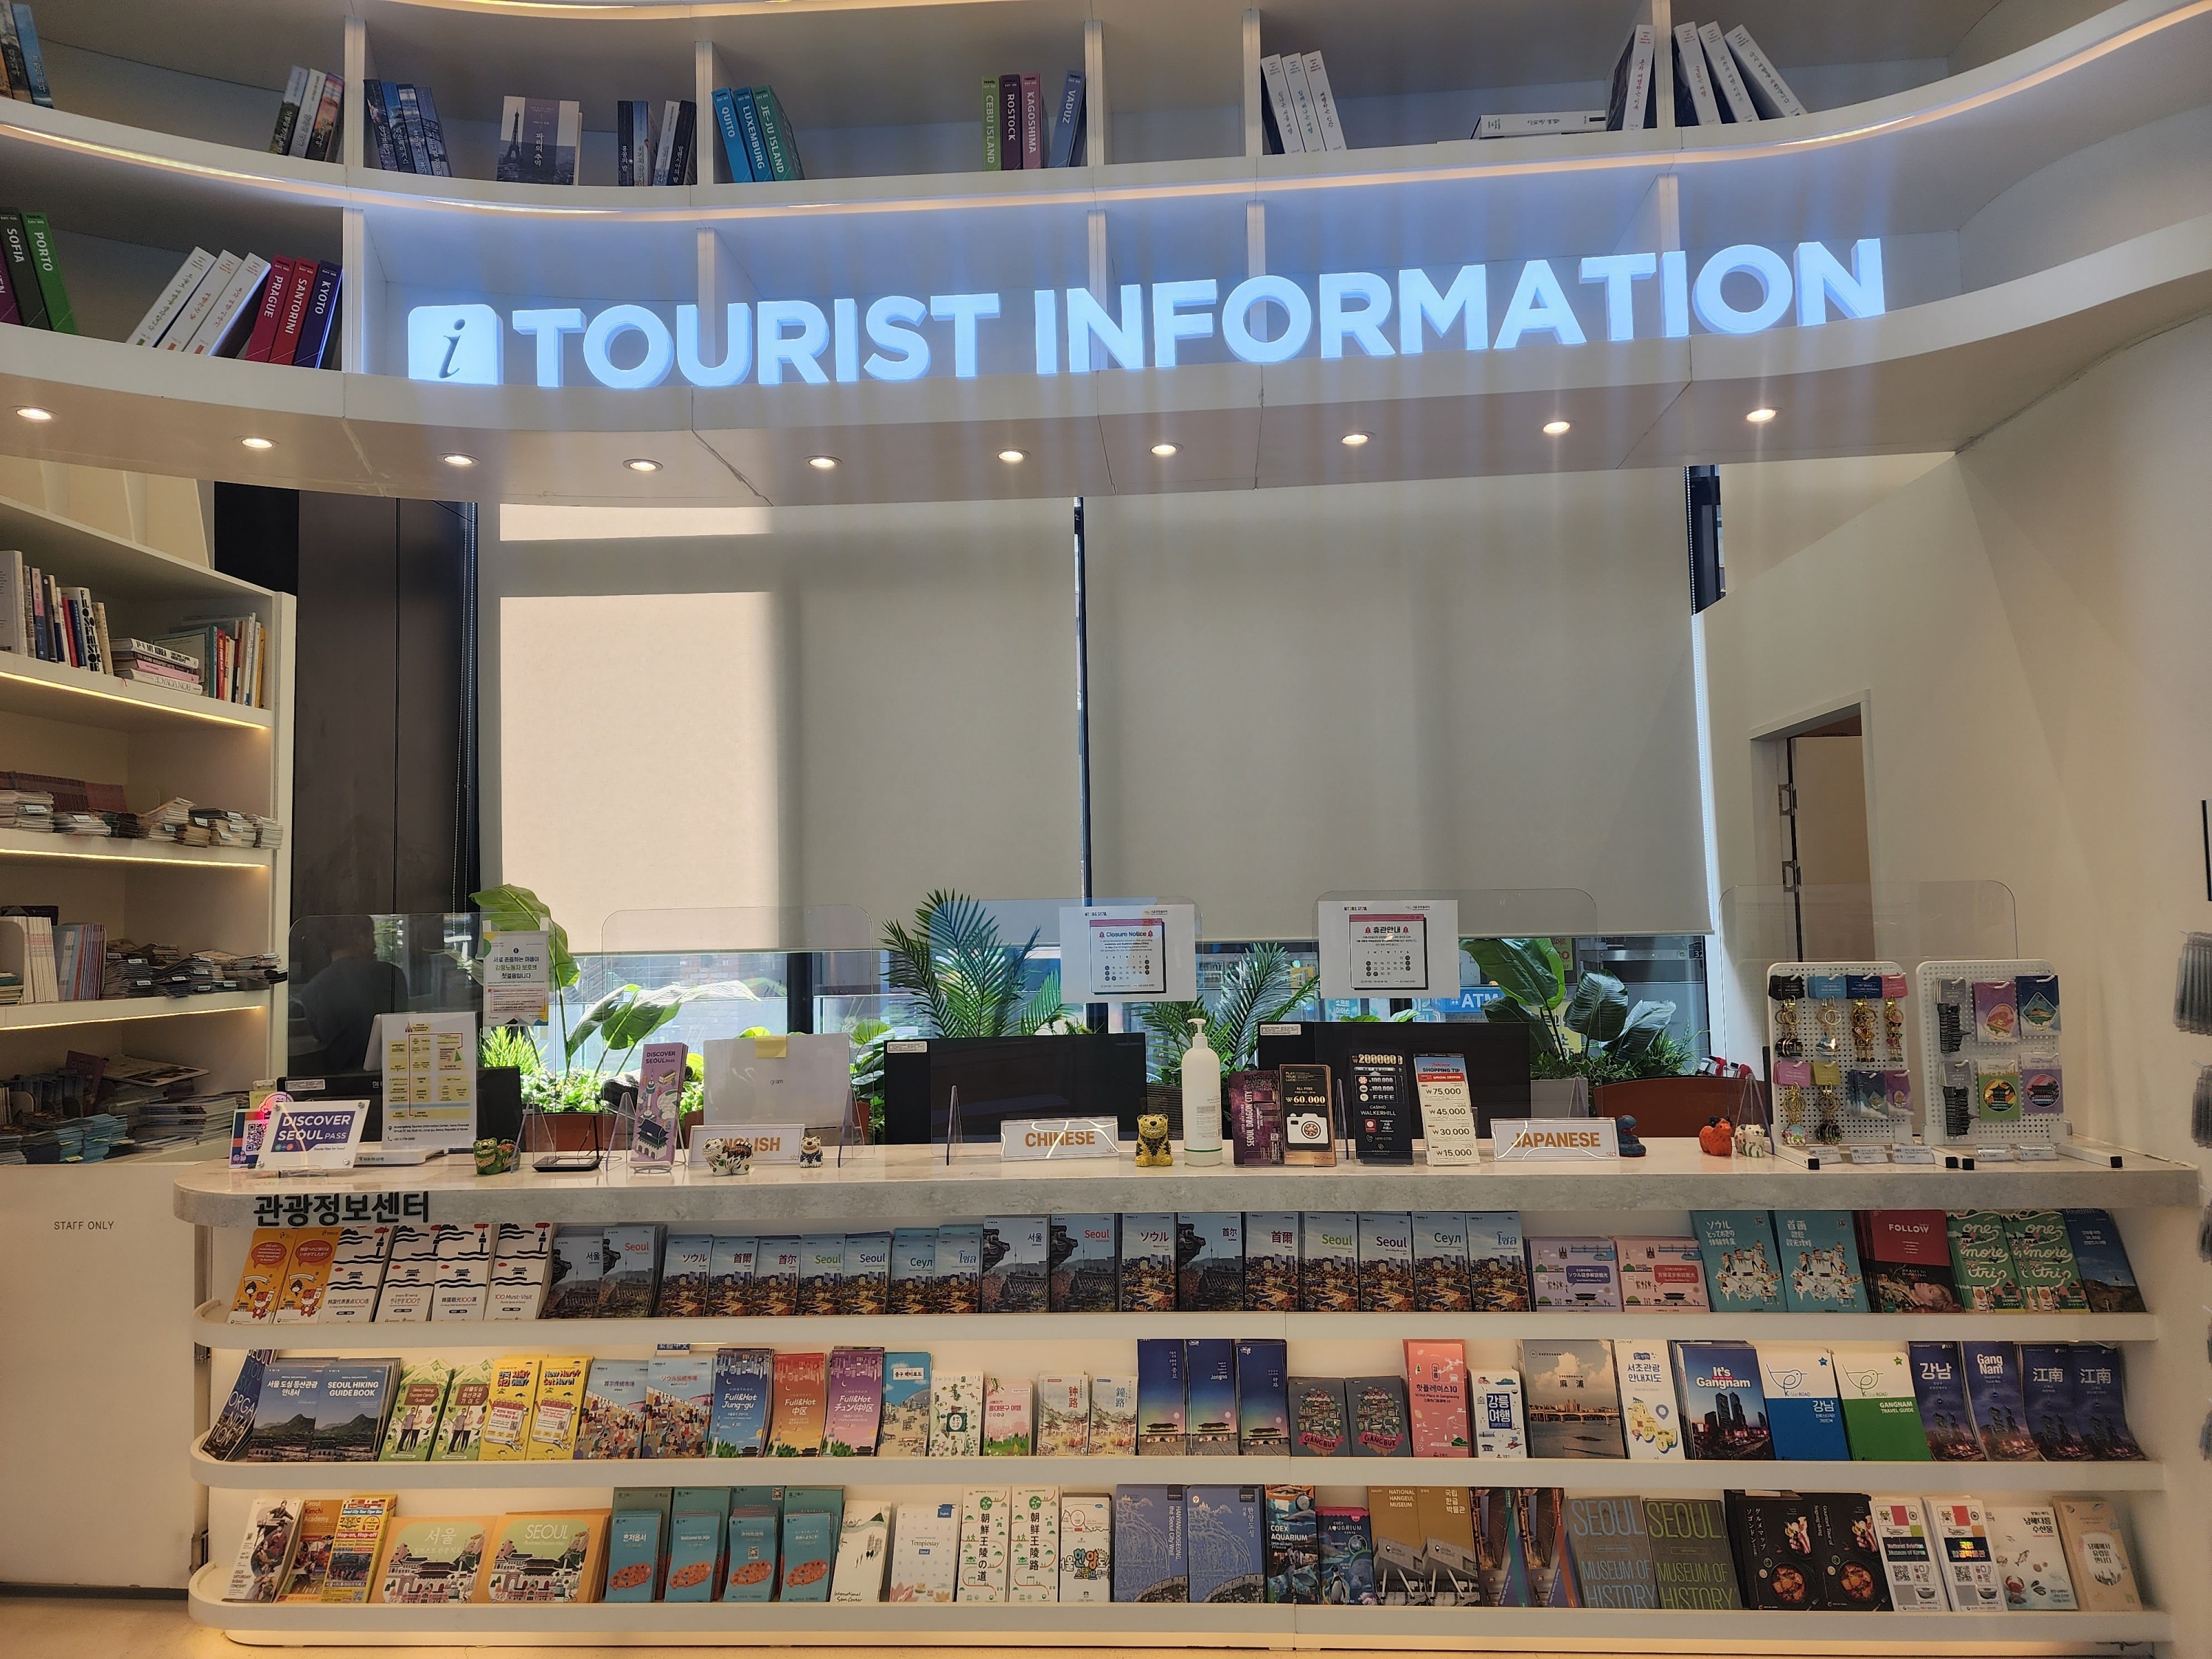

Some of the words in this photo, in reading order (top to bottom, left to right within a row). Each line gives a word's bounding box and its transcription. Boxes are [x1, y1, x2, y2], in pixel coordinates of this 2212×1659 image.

[986, 95, 994, 122] CEBU
[1062, 89, 1076, 125] VADUZ
[722, 106, 735, 138] QUITO
[1007, 93, 1016, 141] ROSTOCK
[1026, 91, 1037, 153] KAGOSHIMA
[535, 133, 544, 153] 파리의
[742, 105, 765, 169] LUXEMBURG
[761, 105, 775, 134] JE-JU
[769, 136, 785, 173] ISLAND
[987, 125, 995, 163] ISLAND
[7, 228, 25, 263] SOFIA
[34, 232, 53, 271] PORTO
[264, 275, 284, 319] PRAGUE
[315, 279, 332, 315] KYOTO
[285, 277, 307, 335] SANTORINI
[512, 292, 1001, 389] TOURIST
[1034, 238, 1886, 375] INFORMATION
[1373, 926, 1401, 934] 휴관안내
[1335, 999, 1350, 1007] 소프트
[646, 1050, 675, 1059] DISCOVER
[645, 1057, 665, 1065] SEOUL
[1245, 1091, 1253, 1102] CITY
[282, 1115, 352, 1127] DISCOVER
[1245, 1102, 1254, 1130] DRAGON
[277, 1129, 324, 1141] SEOUL
[324, 1132, 347, 1140] PASS
[1025, 1131, 1096, 1148] CHINESE
[1246, 1130, 1255, 1147] SEOUL
[1511, 1132, 1601, 1148] JAPANESE
[253, 1193, 429, 1227] 관광정보센터
[53, 1220, 84, 1231] STAFF
[87, 1220, 114, 1231] ONLY
[1705, 1220, 1731, 1230] ソウル
[1888, 1223, 1930, 1234] FOLLOW
[1027, 1232, 1043, 1242] 서울
[1085, 1229, 1110, 1239] Seoul
[1141, 1231, 1169, 1242] ソウル
[1222, 1227, 1238, 1237] 首尔
[1270, 1231, 1293, 1245] 首爾
[1321, 1234, 1353, 1246] Seoul
[1376, 1236, 1408, 1248] Seoul
[1433, 1232, 1461, 1246] Сеул
[625, 1242, 650, 1252] Seoul
[586, 1252, 601, 1260] 서울
[683, 1253, 707, 1263] ソウル
[778, 1254, 797, 1265] 首尔
[815, 1254, 841, 1265] Seoul
[859, 1253, 886, 1263] Seoul
[910, 1257, 933, 1268] Сеул
[1976, 1353, 2003, 1367] Gang
[560, 1370, 581, 1378] Here?
[1627, 1363, 1660, 1373] 서초관광
[1712, 1366, 1731, 1377] It's
[1919, 1363, 1952, 1380] 강남
[1979, 1363, 2003, 1375] Nam
[1627, 1373, 1662, 1383] 안내지도
[2033, 1367, 2064, 1382] 江南
[2079, 1368, 2112, 1385] 江南
[267, 1380, 279, 1388] 서울
[280, 1380, 293, 1388] 도심
[293, 1380, 318, 1388] 등산관광
[327, 1381, 352, 1389] SEOUL
[352, 1381, 379, 1389] HIKING
[1416, 1383, 1458, 1394] 핫플레이스10
[1696, 1377, 1751, 1390] Gangnam
[281, 1388, 300, 1397] 안내서
[350, 1389, 375, 1397] BOOK
[724, 1393, 757, 1402] Full&Hot
[839, 1394, 872, 1402] Full&Hot
[722, 1401, 754, 1410] Jung-gu
[785, 1398, 816, 1406] Full&Hot
[1487, 1394, 1510, 1408] 강릉
[1812, 1400, 1834, 1413] 강남
[1879, 1401, 1913, 1409] GANGNAM
[791, 1406, 807, 1416] 中区
[1488, 1408, 1511, 1422] 여행
[1304, 1435, 1337, 1448] GANGBUK
[1444, 1489, 1458, 1498] 국립
[1445, 1498, 1458, 1506] 한글
[1446, 1506, 1466, 1514] 박물관
[1571, 1499, 1644, 1538] SEOUL
[1646, 1501, 1724, 1539] SEOUL
[525, 1524, 568, 1540] SEOUL
[1270, 1525, 1289, 1533] COEX
[2033, 1526, 2053, 1534] 수산물
[425, 1527, 456, 1545] 서울
[1029, 1512, 1040, 1571] 朝鮮王陵路
[1270, 1534, 1308, 1543] AQUARIUM
[910, 1540, 940, 1548] Templestay
[977, 1512, 990, 1582] 朝鮮王陵の道
[1581, 1559, 1634, 1580] MUSEUM
[1636, 1559, 1652, 1579] OF
[1656, 1562, 1709, 1583] MUSEUM
[1711, 1562, 1728, 1582] OF
[1585, 1584, 1658, 1608] HISTORY
[1662, 1586, 1734, 1610] HISTORY
